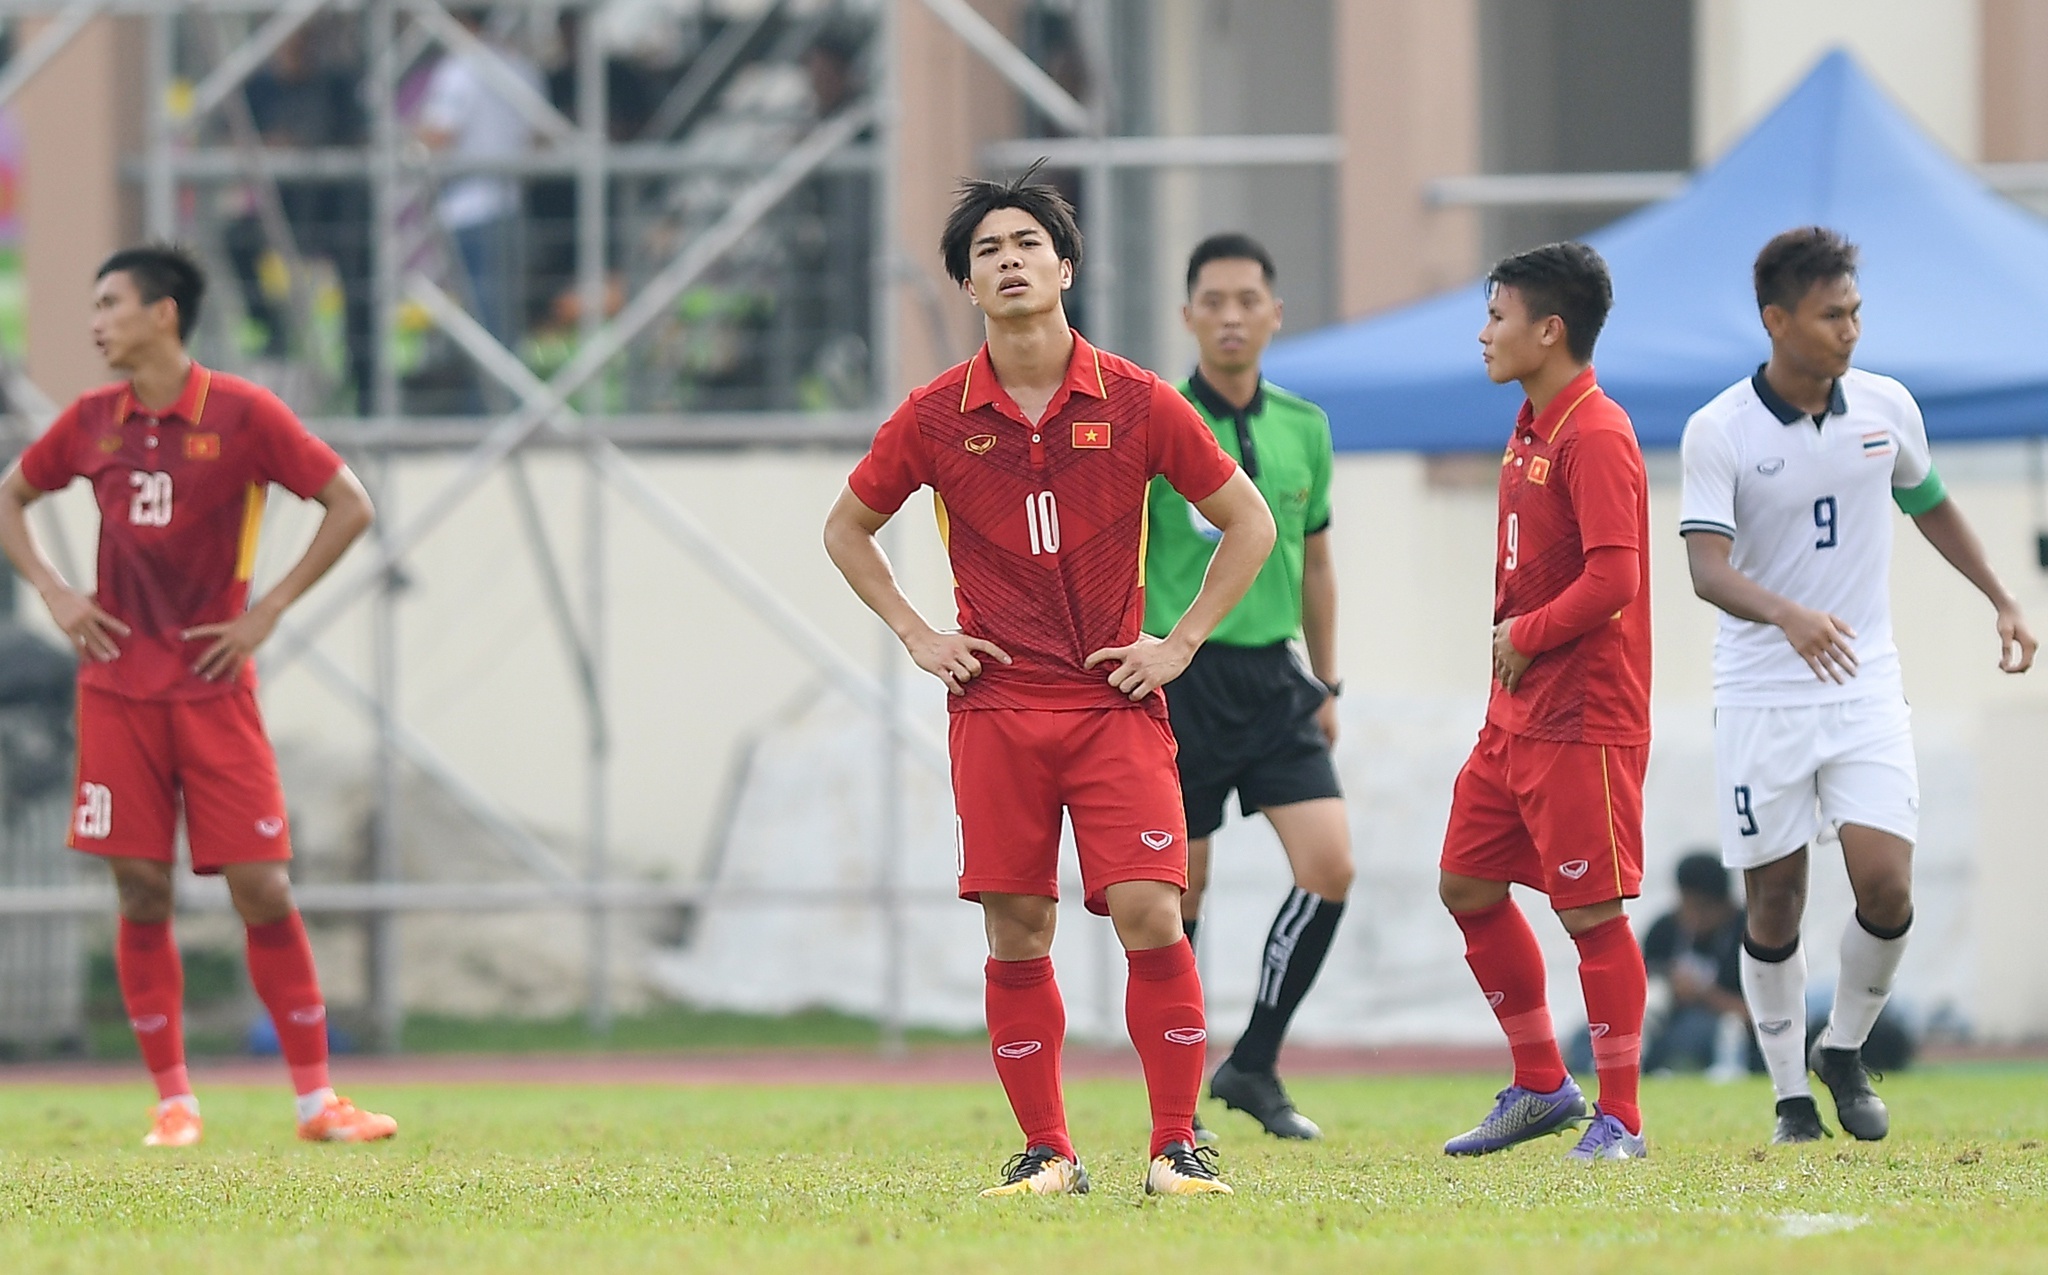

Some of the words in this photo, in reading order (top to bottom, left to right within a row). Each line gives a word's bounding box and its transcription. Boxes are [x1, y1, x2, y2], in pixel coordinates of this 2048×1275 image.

[128, 470, 173, 527] 20
[1025, 490, 1060, 555] 10
[1814, 495, 1836, 549] 9
[1505, 512, 1518, 571] 9
[75, 781, 112, 839] 20
[1734, 785, 1759, 836] 9
